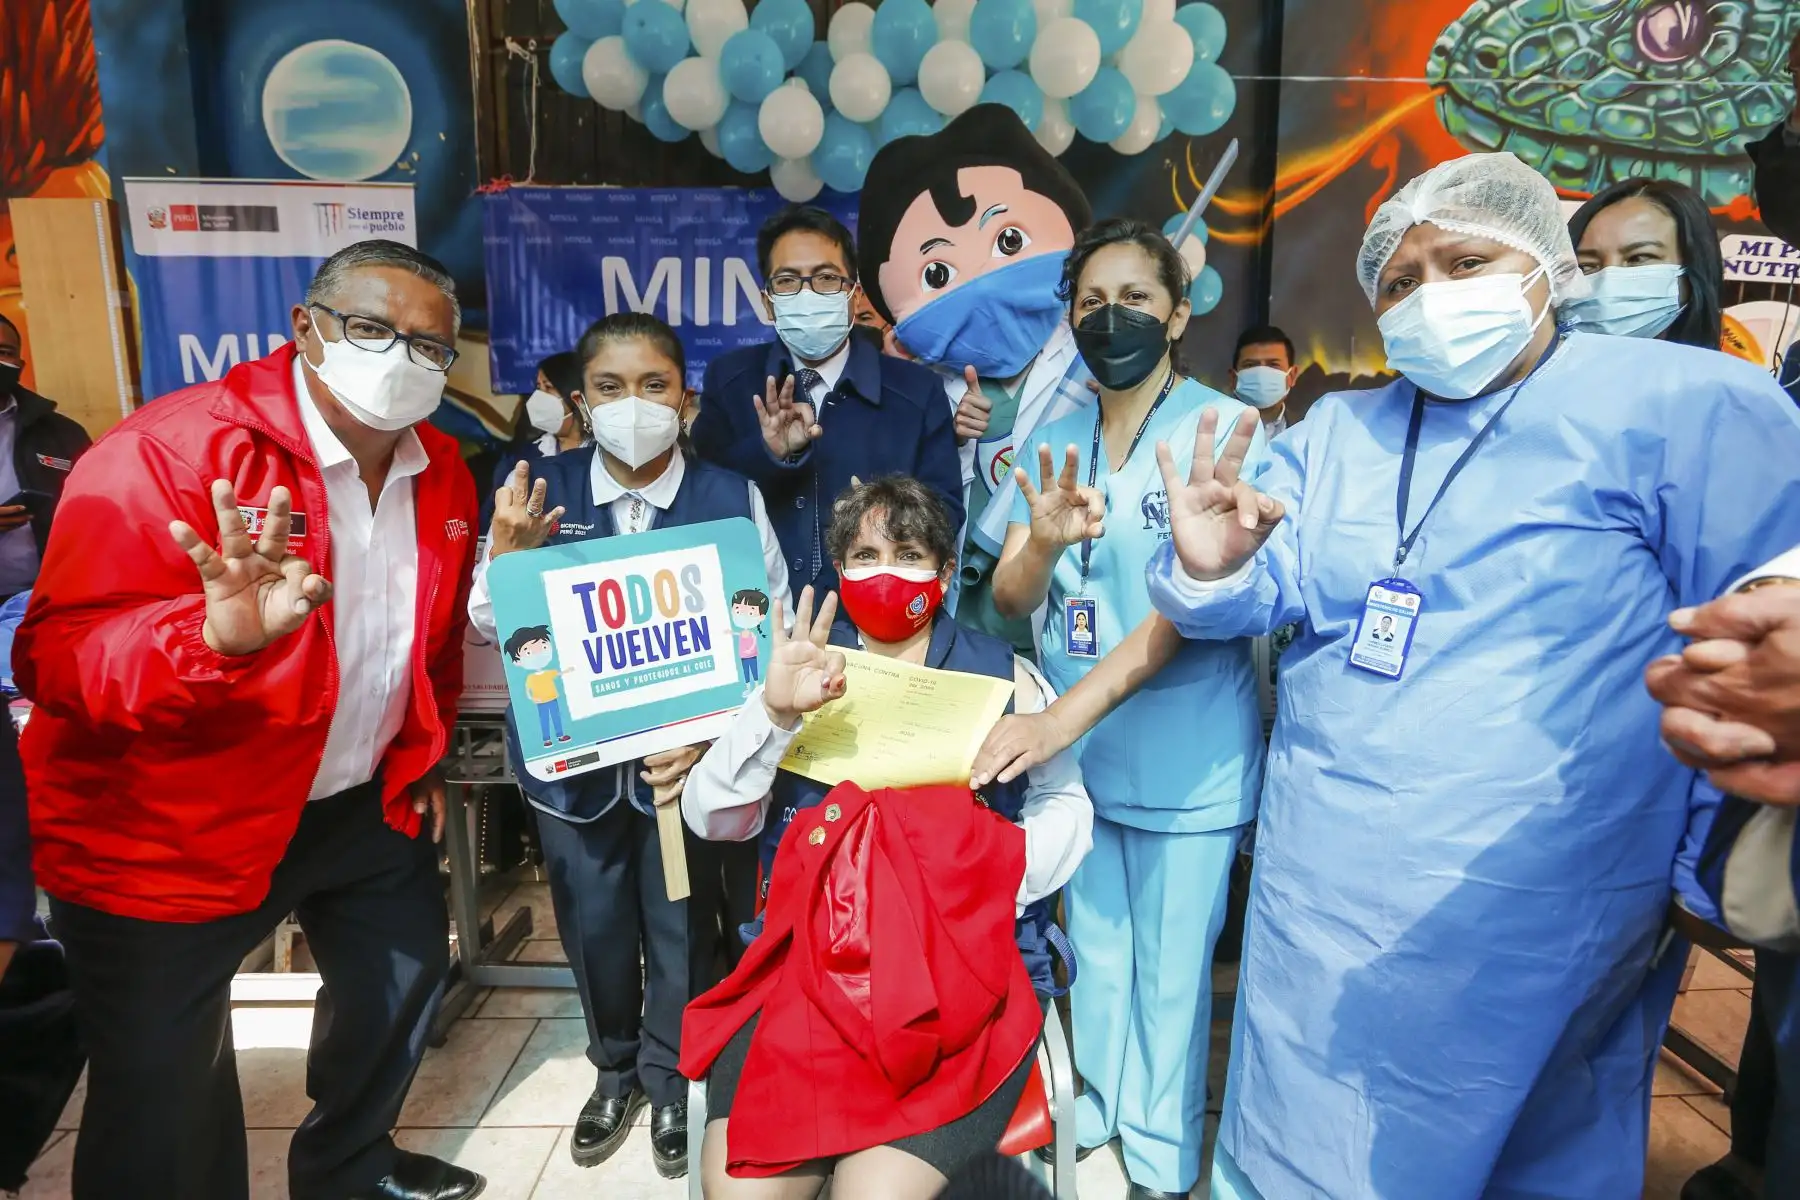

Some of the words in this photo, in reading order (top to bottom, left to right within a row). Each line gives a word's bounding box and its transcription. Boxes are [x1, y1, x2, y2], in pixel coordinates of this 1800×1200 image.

[347, 206, 404, 222] Siempre
[369, 221, 405, 234] pueblo
[564, 235, 593, 245] MINSA
[1738, 240, 1773, 257] MI
[695, 337, 723, 346] MINSA
[571, 563, 706, 634] TODOS
[582, 615, 712, 675] VUELVEN
[595, 681, 621, 694] SANOS
[624, 677, 631, 687] Y
[634, 666, 680, 685] PROTEGIDOS
[694, 659, 713, 671] COLE
[873, 667, 900, 679] CONTRA
[908, 676, 937, 686] COVID-19
